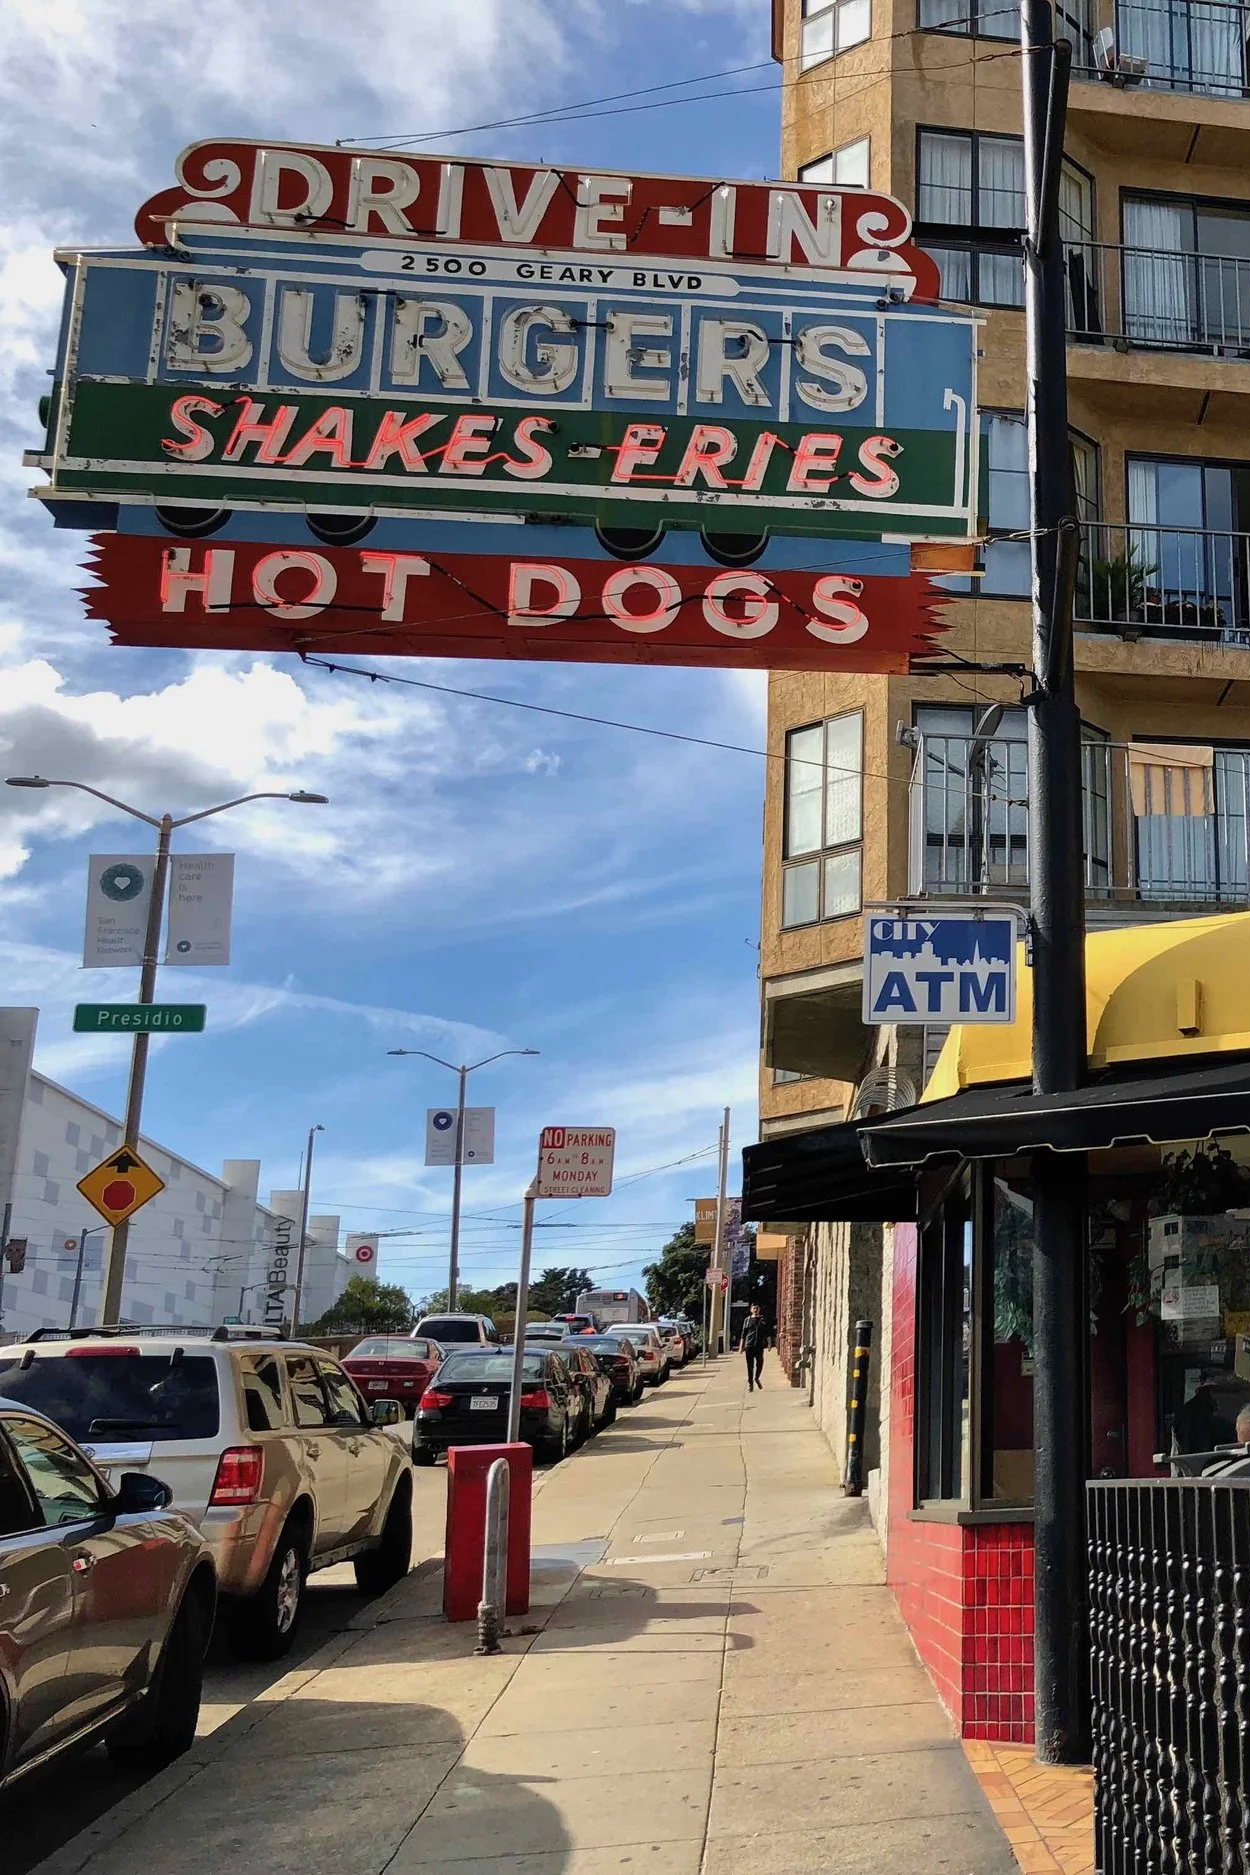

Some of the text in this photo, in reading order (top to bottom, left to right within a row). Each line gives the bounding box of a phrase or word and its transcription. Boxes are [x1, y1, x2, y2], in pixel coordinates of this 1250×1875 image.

[248, 148, 843, 268] DRIVE-IN
[400, 255, 703, 290] 2500 GEARY BLVD
[164, 277, 872, 413] BURGERS
[160, 546, 870, 645] HOT DOGS
[873, 921, 940, 941] CITY
[872, 971, 1006, 1013] ATM
[97, 1011, 183, 1026] Presidio
[543, 1129, 612, 1147] NO PARKING
[547, 1151, 555, 1165] 6
[581, 1152, 590, 1165] 8
[552, 1170, 599, 1182] MONDAY
[544, 1186, 605, 1194] STREET CLEANING
[267, 1215, 296, 1284] Beauty
